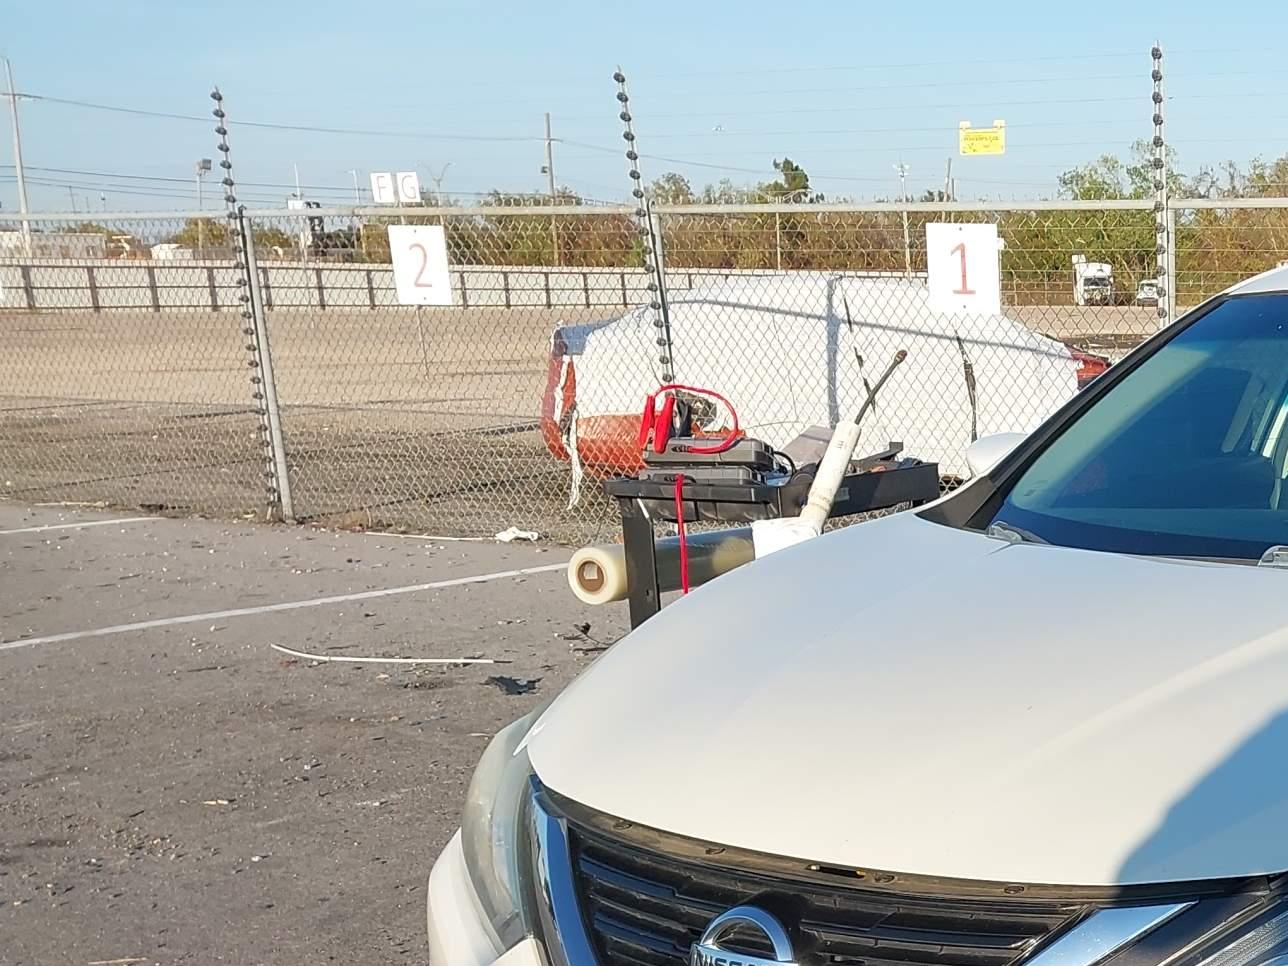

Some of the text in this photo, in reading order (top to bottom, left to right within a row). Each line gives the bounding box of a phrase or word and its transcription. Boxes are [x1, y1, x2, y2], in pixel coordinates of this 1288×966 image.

[401, 175, 416, 199] G
[409, 243, 432, 287] 2
[950, 242, 977, 295] 1
